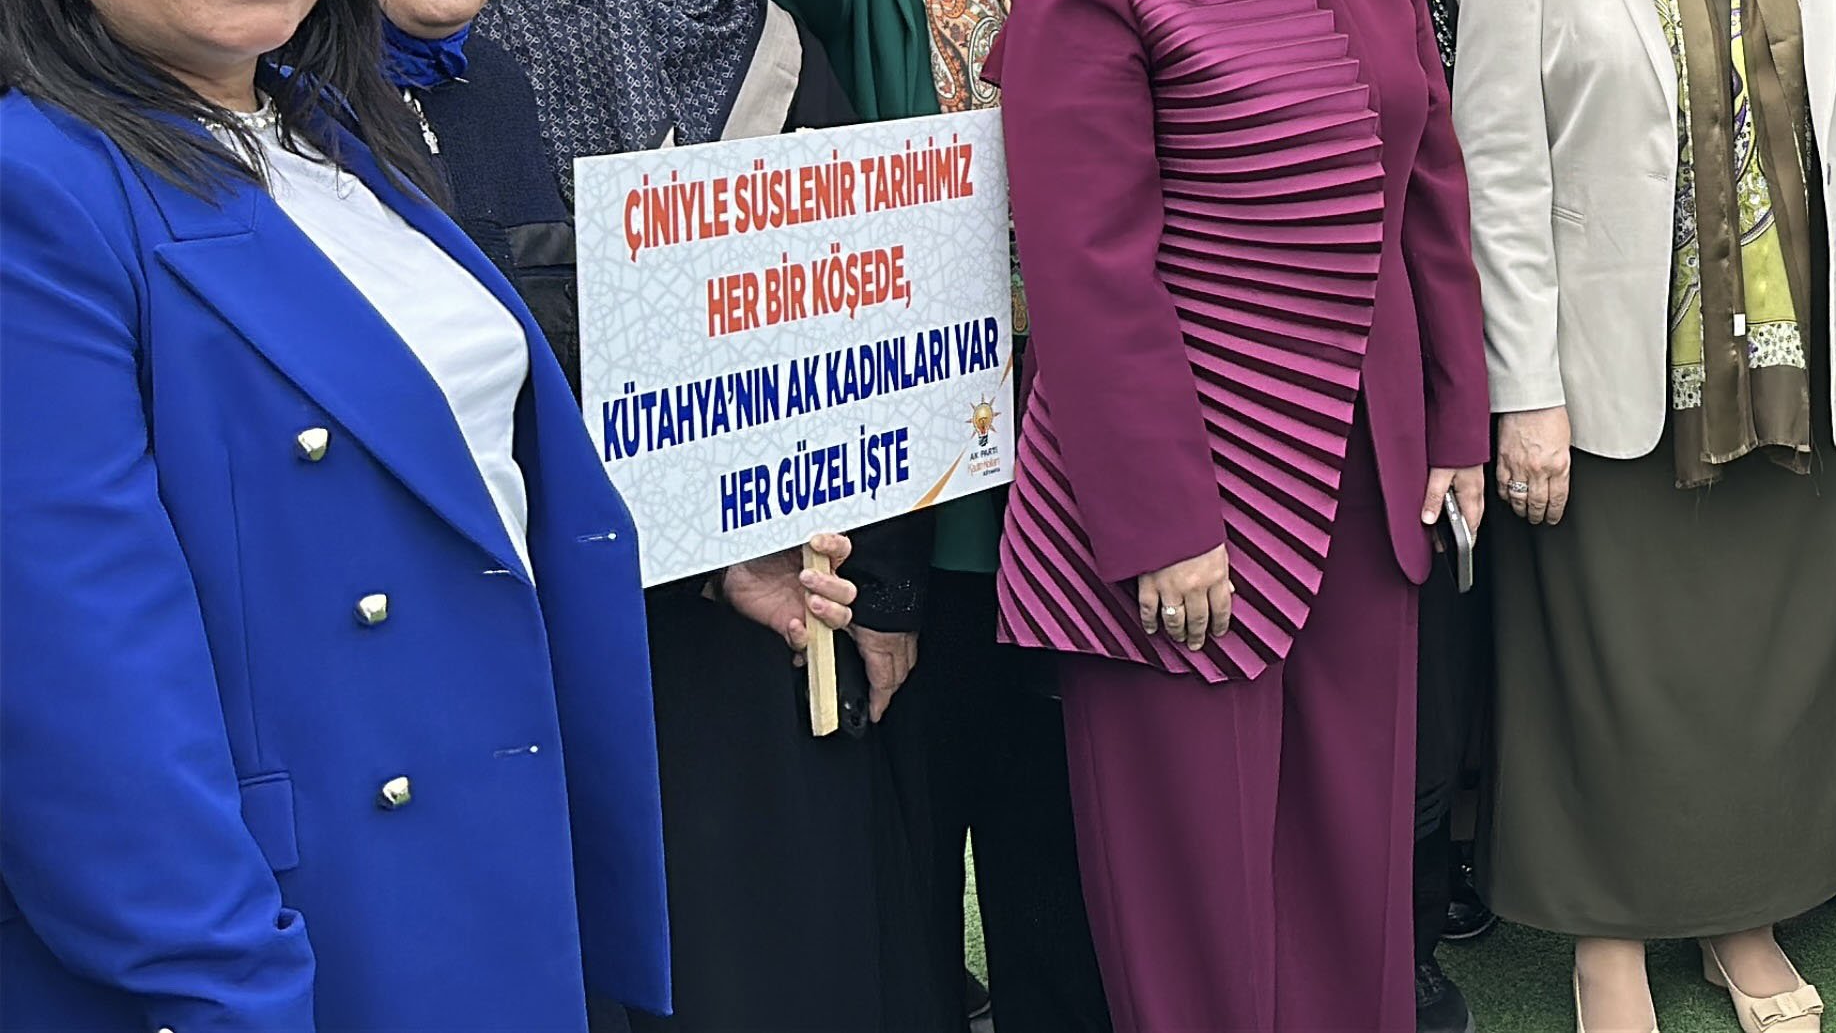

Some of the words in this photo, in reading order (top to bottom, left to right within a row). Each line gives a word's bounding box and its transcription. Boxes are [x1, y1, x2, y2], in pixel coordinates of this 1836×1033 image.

[624, 170, 729, 262] ÇİNİYLE
[734, 149, 856, 234] SÜSLENİR
[859, 133, 974, 214] TARİHİMİZ
[706, 272, 761, 338] HER
[765, 252, 808, 326] BİR
[812, 243, 912, 321] KÖŞEDE,
[785, 355, 821, 419] AK
[826, 326, 951, 410] KADINLARI
[954, 316, 1000, 377] VAR
[720, 464, 773, 534] HER
[777, 436, 856, 516] GÜZEL
[860, 423, 910, 501] İŞTE
